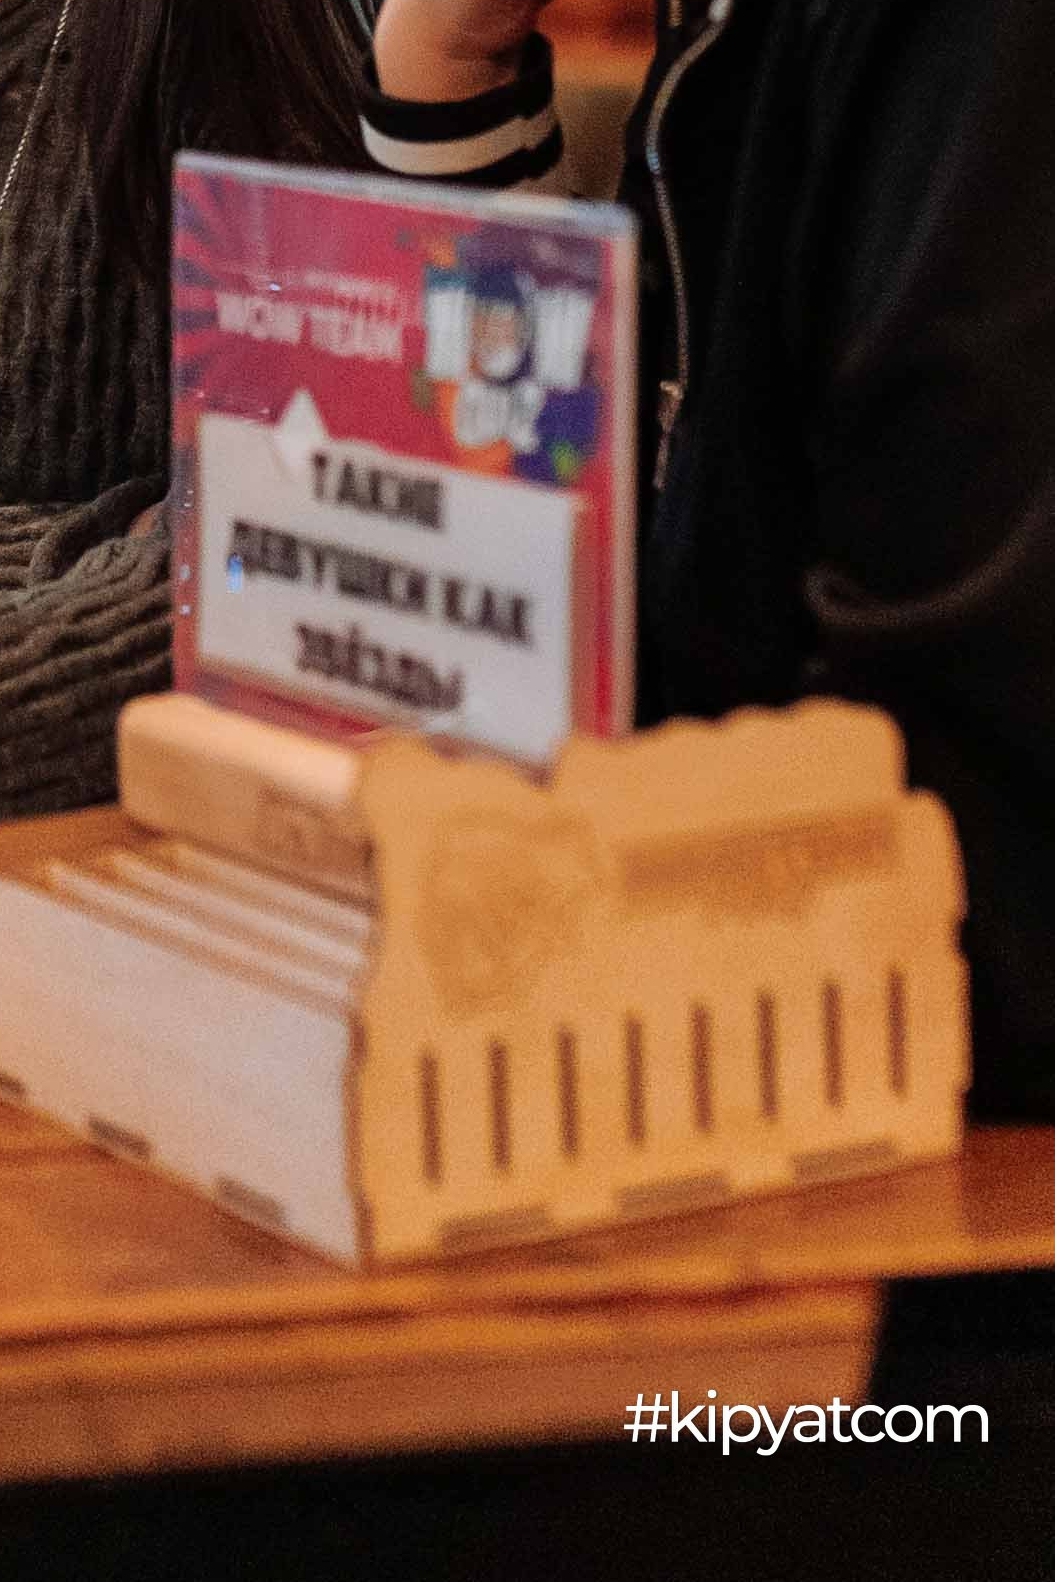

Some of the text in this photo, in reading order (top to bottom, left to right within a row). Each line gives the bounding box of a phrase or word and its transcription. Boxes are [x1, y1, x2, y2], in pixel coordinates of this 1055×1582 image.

[310, 450, 446, 532] ТАКИЕ
[229, 519, 534, 648] ДЕВУШКИ КАК
